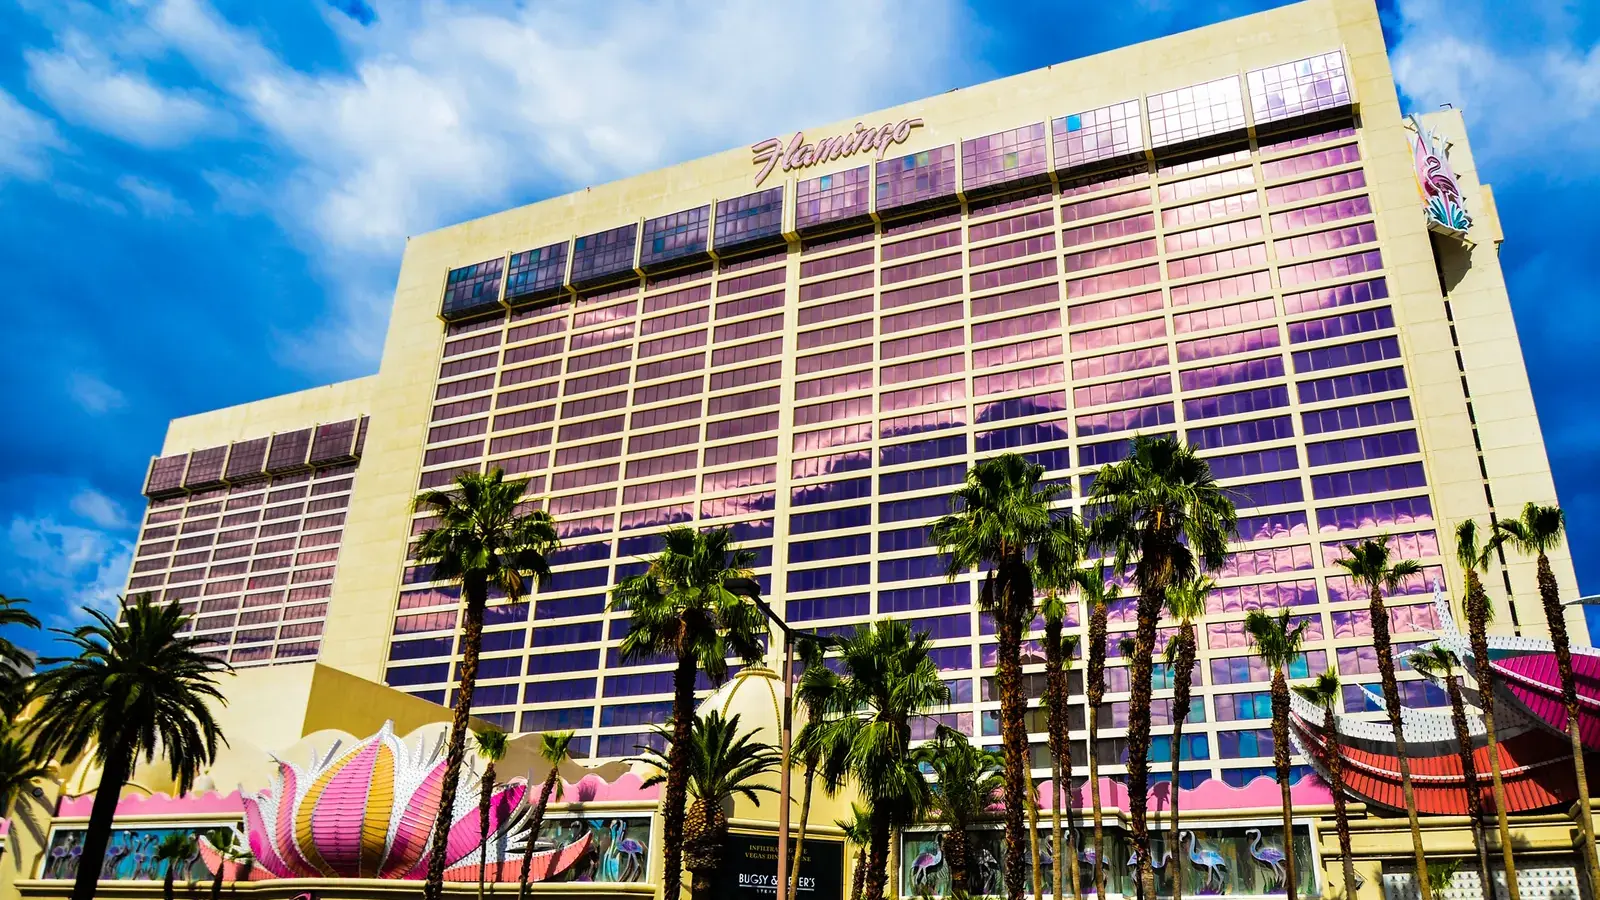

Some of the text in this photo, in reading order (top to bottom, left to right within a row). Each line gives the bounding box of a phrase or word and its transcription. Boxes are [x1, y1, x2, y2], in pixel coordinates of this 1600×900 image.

[751, 118, 924, 188] Flamingo
[749, 844, 794, 854] INFILTRAG
[739, 873, 769, 885] BUGSY
[770, 875, 778, 886] &
